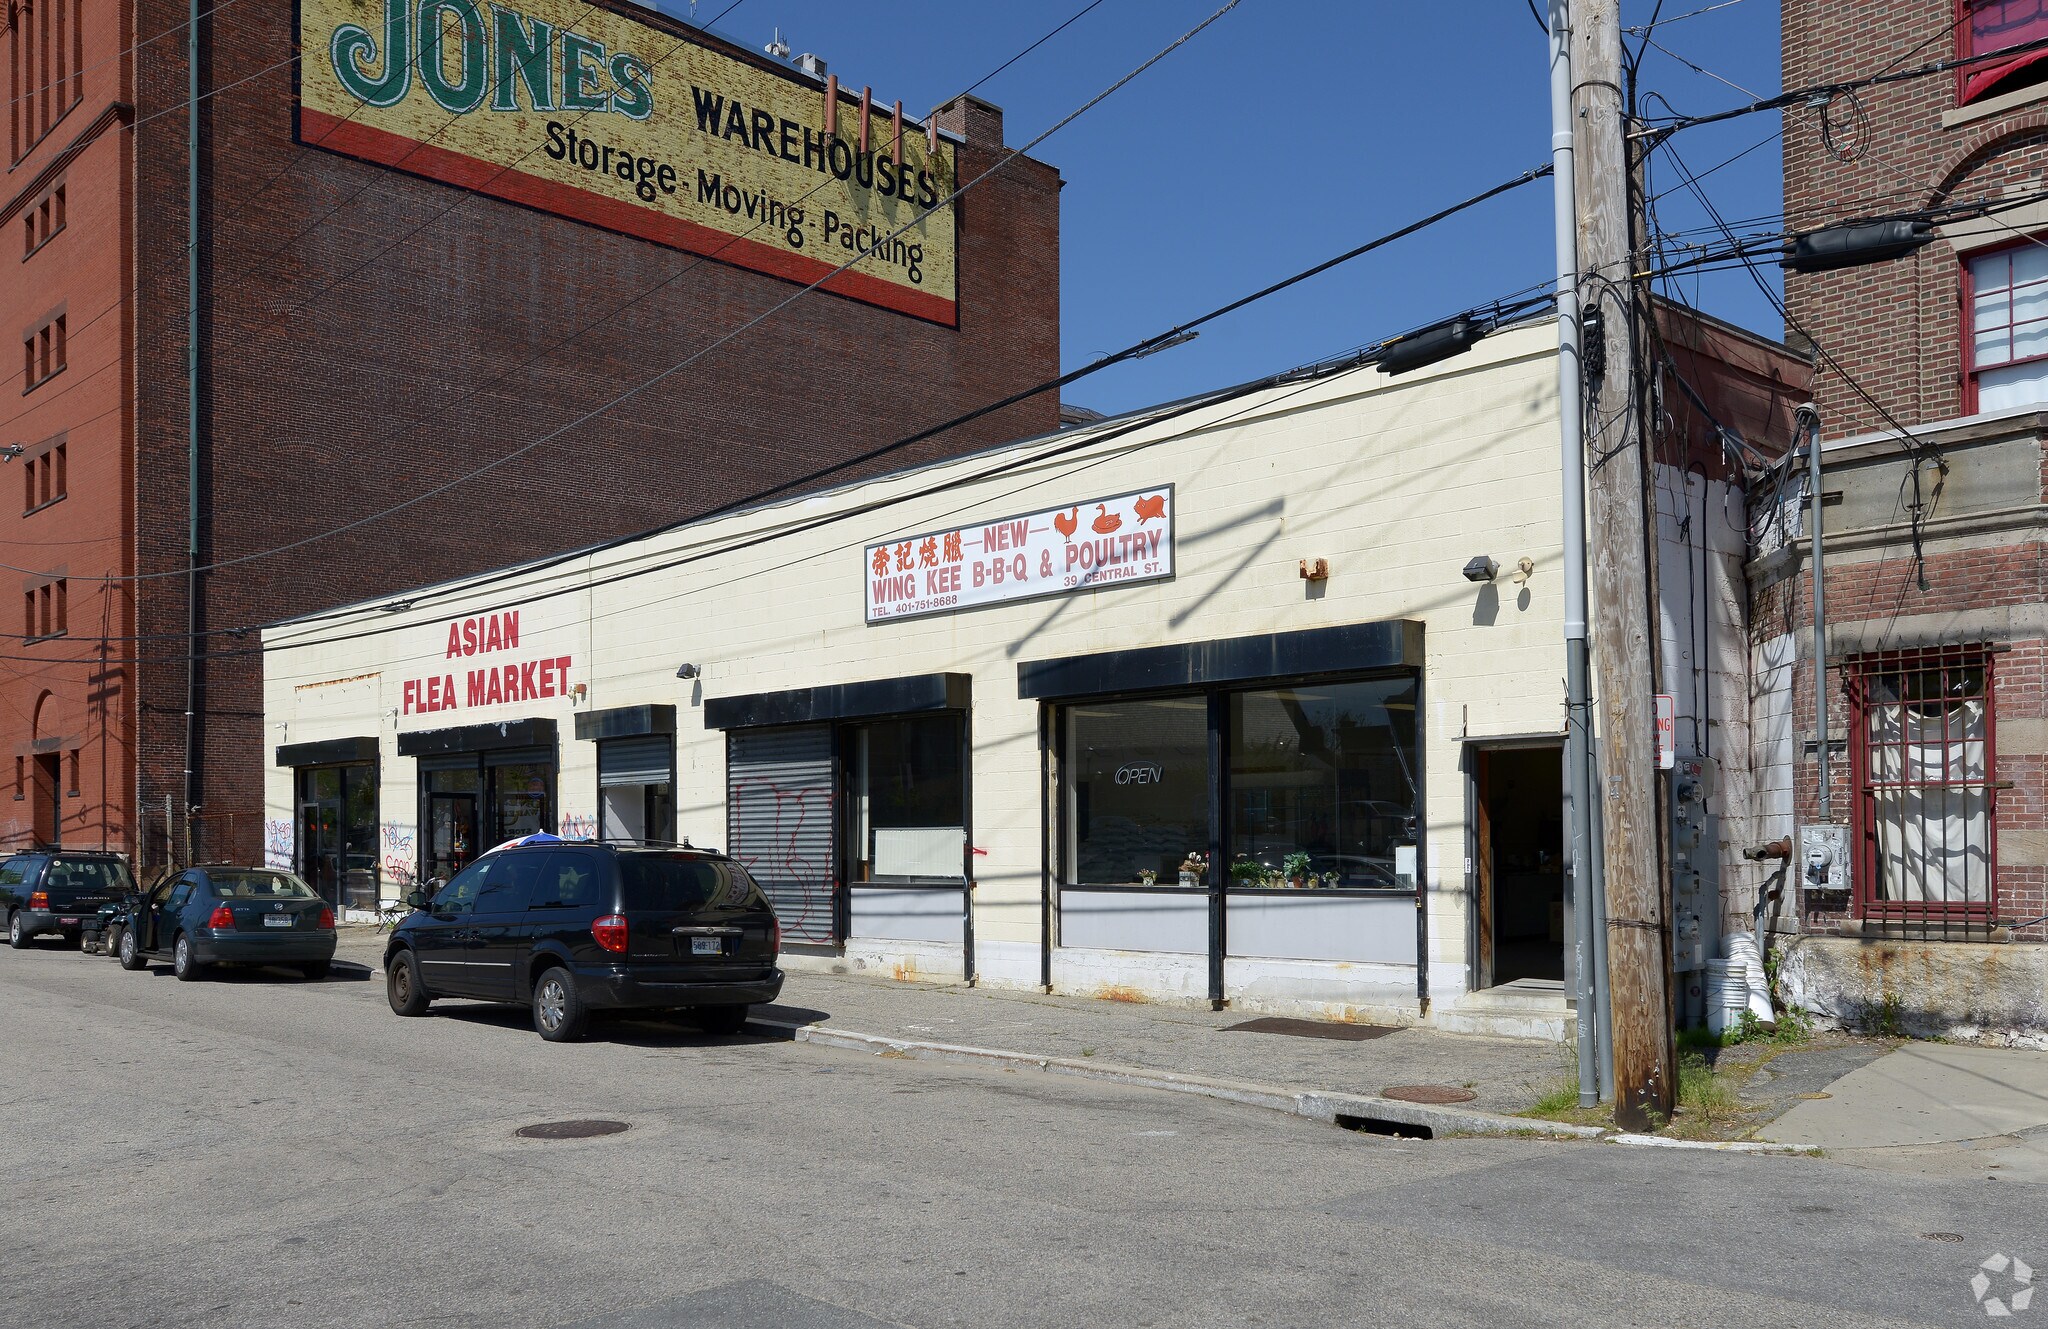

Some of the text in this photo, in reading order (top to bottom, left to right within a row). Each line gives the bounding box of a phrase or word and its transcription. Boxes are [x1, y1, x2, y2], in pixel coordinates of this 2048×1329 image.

[330, 0, 653, 120] JONES
[691, 85, 938, 210] WAREHOUSES
[544, 121, 677, 203] Storage
[697, 168, 805, 248] Moving
[824, 209, 924, 284] Packing
[872, 528, 1163, 604] WING KEE B-B-Q & POULTRY
[1064, 562, 1163, 587] 39 CENTRAL ST.
[446, 610, 519, 659] ASIAN
[872, 606, 891, 617] TEL.
[404, 655, 572, 715] FLEA MARKET
[1118, 767, 1162, 784] OPEN
